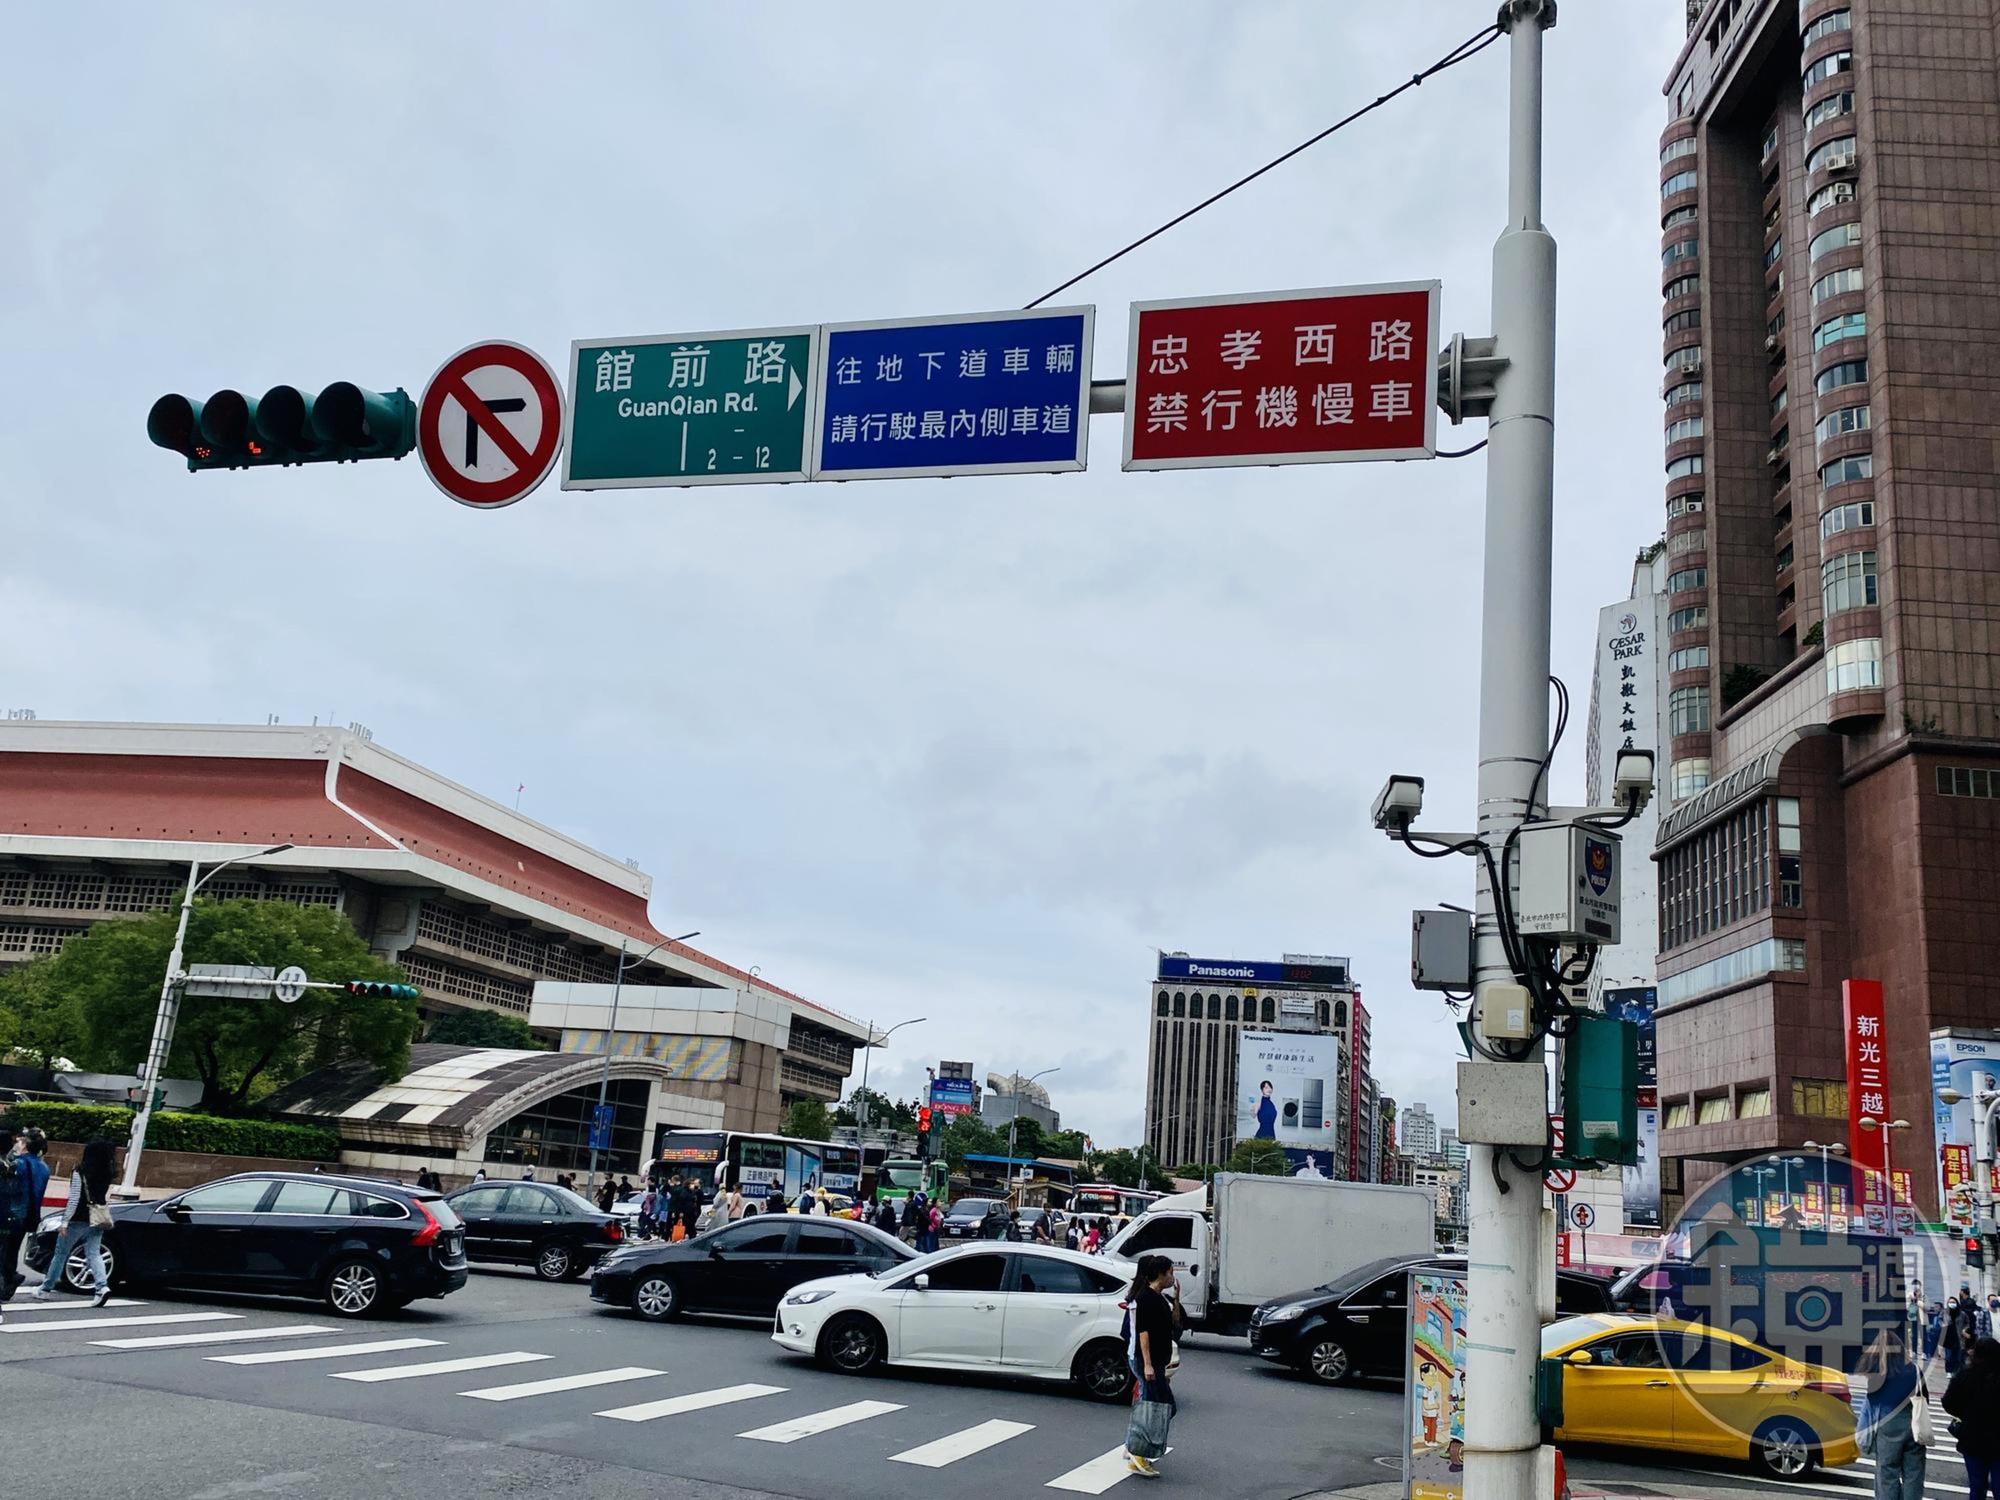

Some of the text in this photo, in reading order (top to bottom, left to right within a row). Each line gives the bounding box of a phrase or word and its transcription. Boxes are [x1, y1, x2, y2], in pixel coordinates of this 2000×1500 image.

[595, 340, 787, 393] 館前路
[836, 344, 1075, 385] 往地下道車輛
[1149, 319, 1413, 375] 忠孝西路
[618, 392, 759, 418] GuanQian Rd.
[831, 404, 1071, 444] 請行駛最內側車道
[1147, 380, 1413, 433] 禁行機慢車
[1613, 645, 1642, 660] PARK
[1188, 964, 1255, 978] Panasonic
[1857, 1015, 1884, 1114] 新光三越
[1956, 1043, 1986, 1053] EPSON
